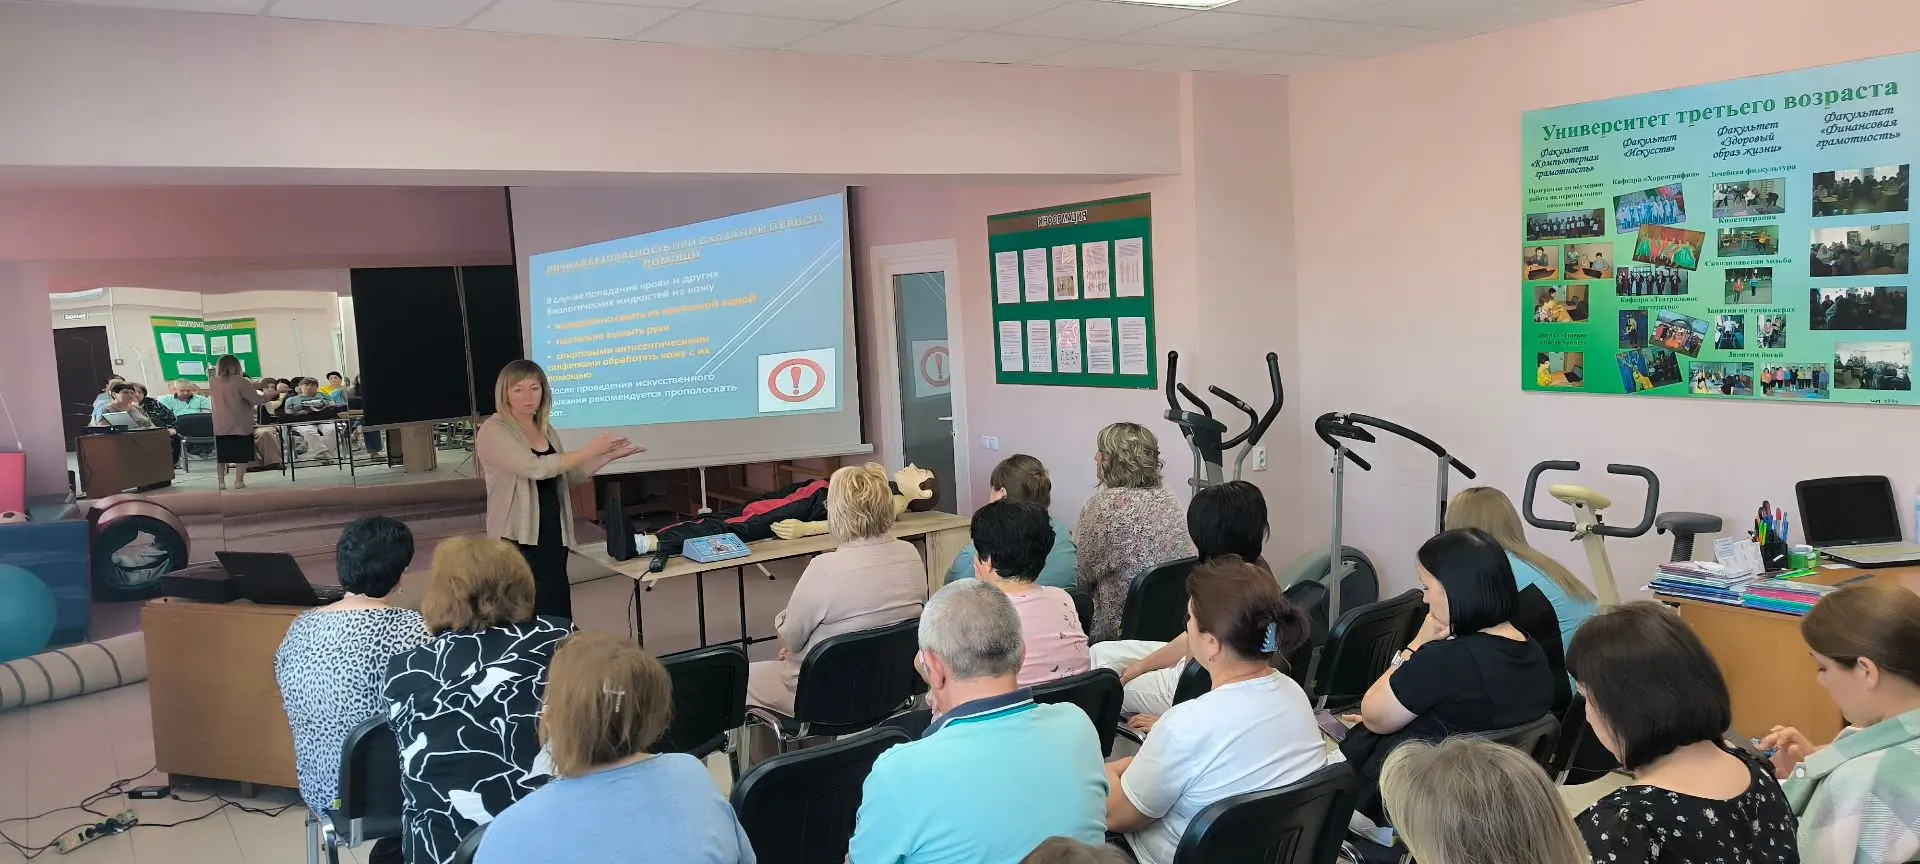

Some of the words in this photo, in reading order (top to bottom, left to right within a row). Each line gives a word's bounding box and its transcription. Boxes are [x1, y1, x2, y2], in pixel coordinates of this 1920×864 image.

[1542, 113, 1670, 141] Университет
[1676, 97, 1776, 127] третьего
[1784, 81, 1899, 109] возраста
[1824, 107, 1894, 123] Факультет
[1717, 122, 1779, 137] Факультет
[1820, 119, 1898, 136] «Финансовая
[1623, 134, 1677, 148] Факультет
[1720, 132, 1775, 146] «Здоровый
[1816, 131, 1901, 150] грамотность»
[1540, 145, 1589, 158] Факультет
[1623, 146, 1676, 158] «Искусств»
[1713, 148, 1741, 160] образ
[1743, 145, 1782, 157] жизни»
[1531, 155, 1599, 168] «Компьютерная
[1535, 167, 1594, 180] грамотность»
[585, 284, 638, 299] попадания
[640, 279, 670, 291] крови
[682, 270, 719, 286] других
[615, 289, 670, 304] жидкостей
[687, 283, 715, 296] кожу
[576, 380, 633, 394] проведения
[635, 374, 716, 389] искусственного
[588, 389, 662, 405] рекомендуется
[664, 384, 738, 399] прополоскать
